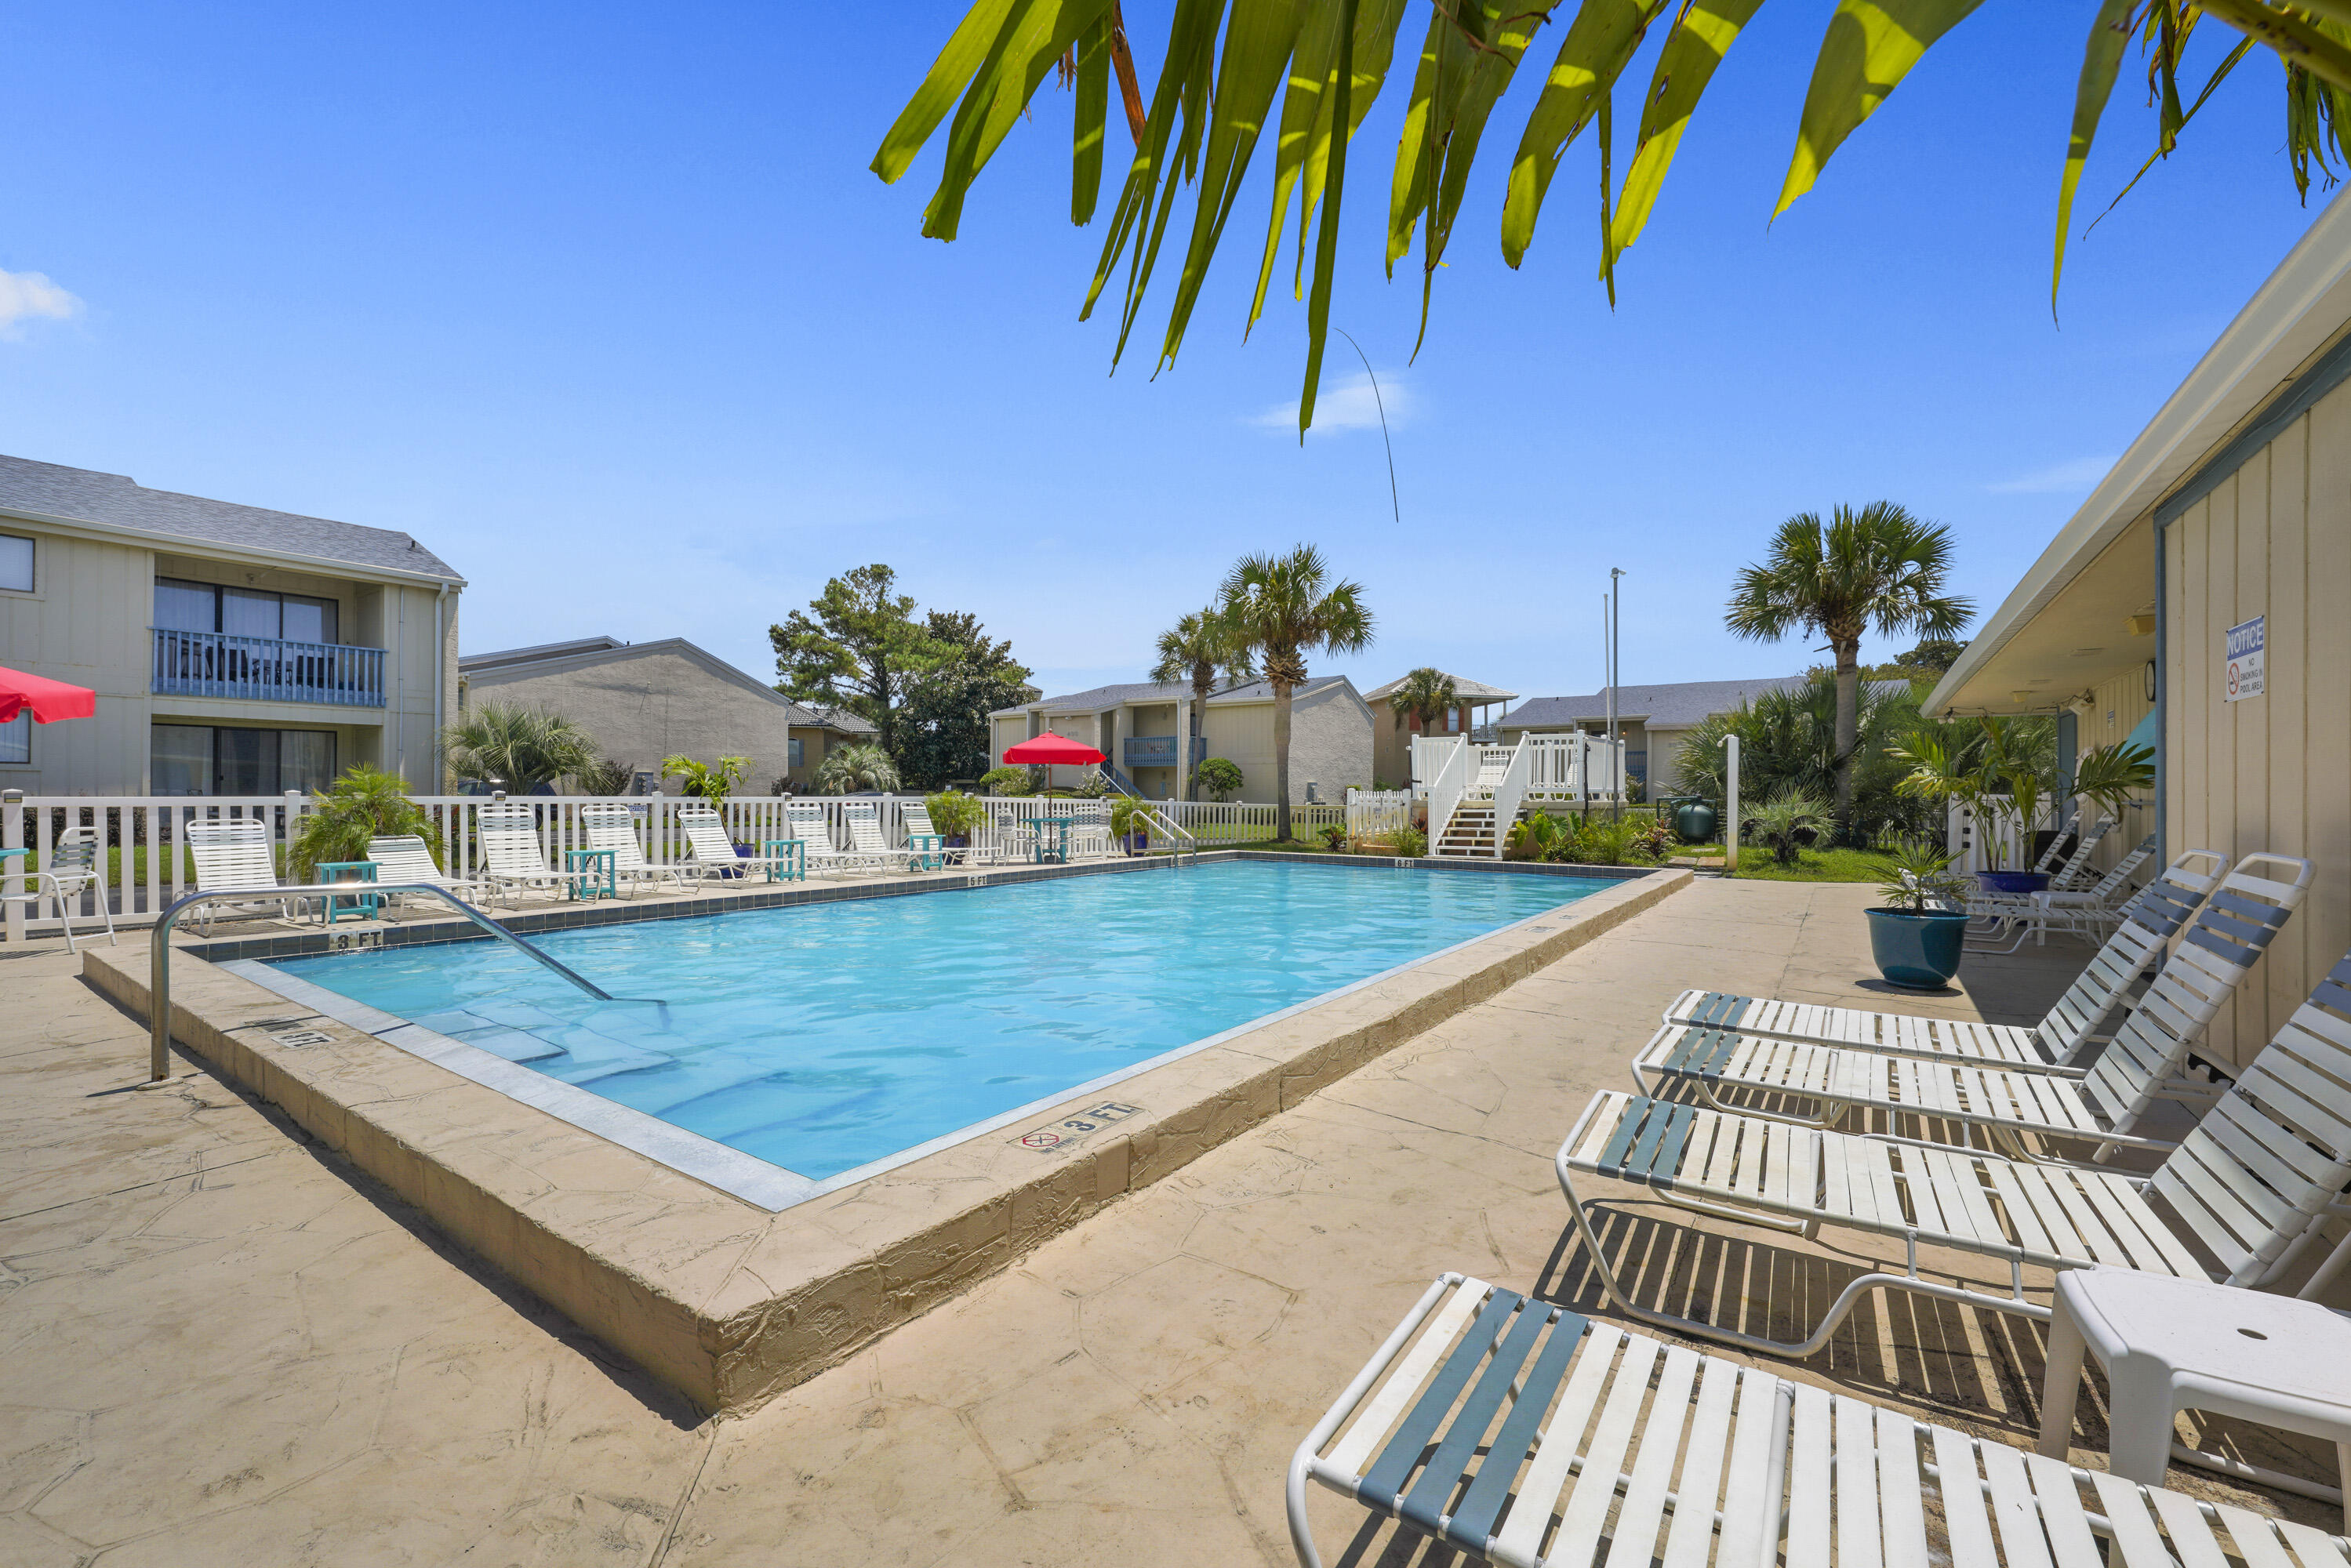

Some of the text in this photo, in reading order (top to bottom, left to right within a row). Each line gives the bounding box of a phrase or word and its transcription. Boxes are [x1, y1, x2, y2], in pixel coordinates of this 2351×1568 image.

[2227, 622, 2263, 655] NOTICE
[2248, 658, 2255, 666] NO
[2240, 668, 2263, 681] SMOKING IN
[2240, 681, 2263, 694] POOL AREA
[970, 877, 975, 886] 5
[337, 935, 349, 949] 3
[1063, 1120, 1096, 1131] 3
